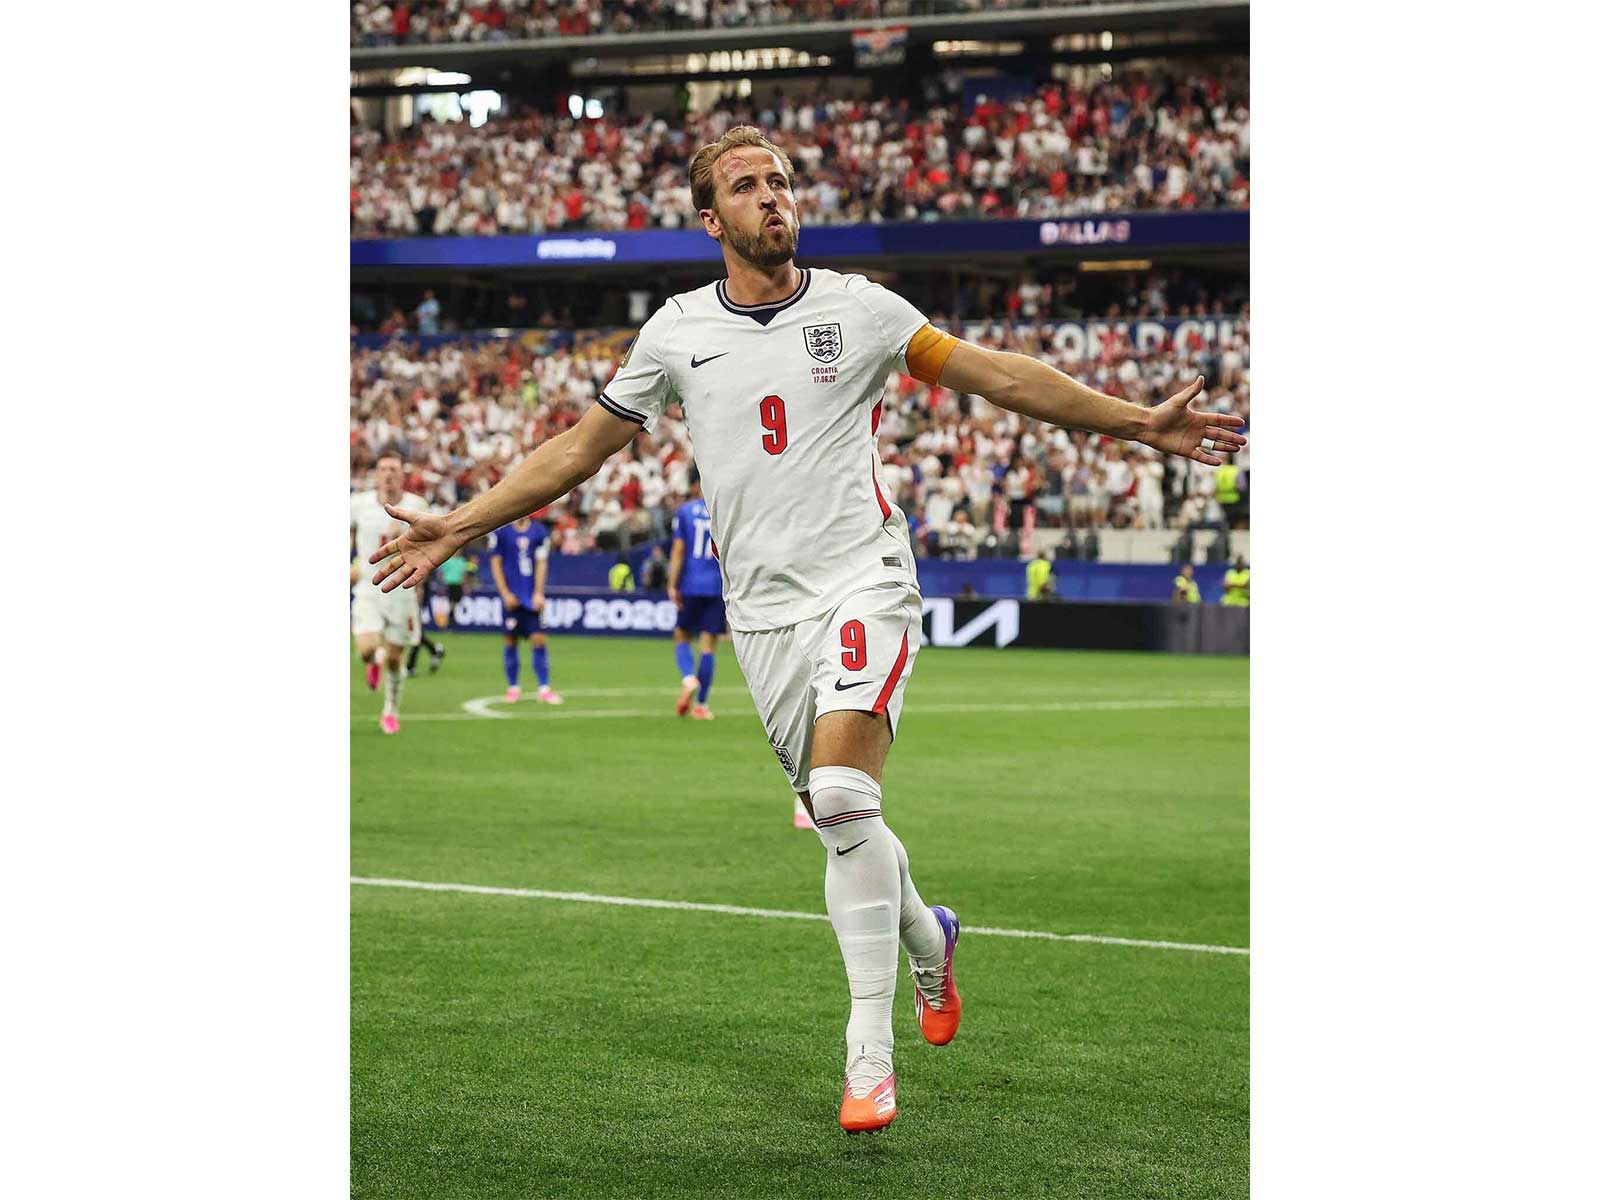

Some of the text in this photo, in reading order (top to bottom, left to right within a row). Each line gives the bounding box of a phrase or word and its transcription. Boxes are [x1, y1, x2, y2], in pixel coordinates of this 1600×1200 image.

[811, 367, 838, 375] CROATIA
[760, 395, 788, 455] 9
[583, 599, 678, 631] 2026
[840, 619, 867, 671] 9
